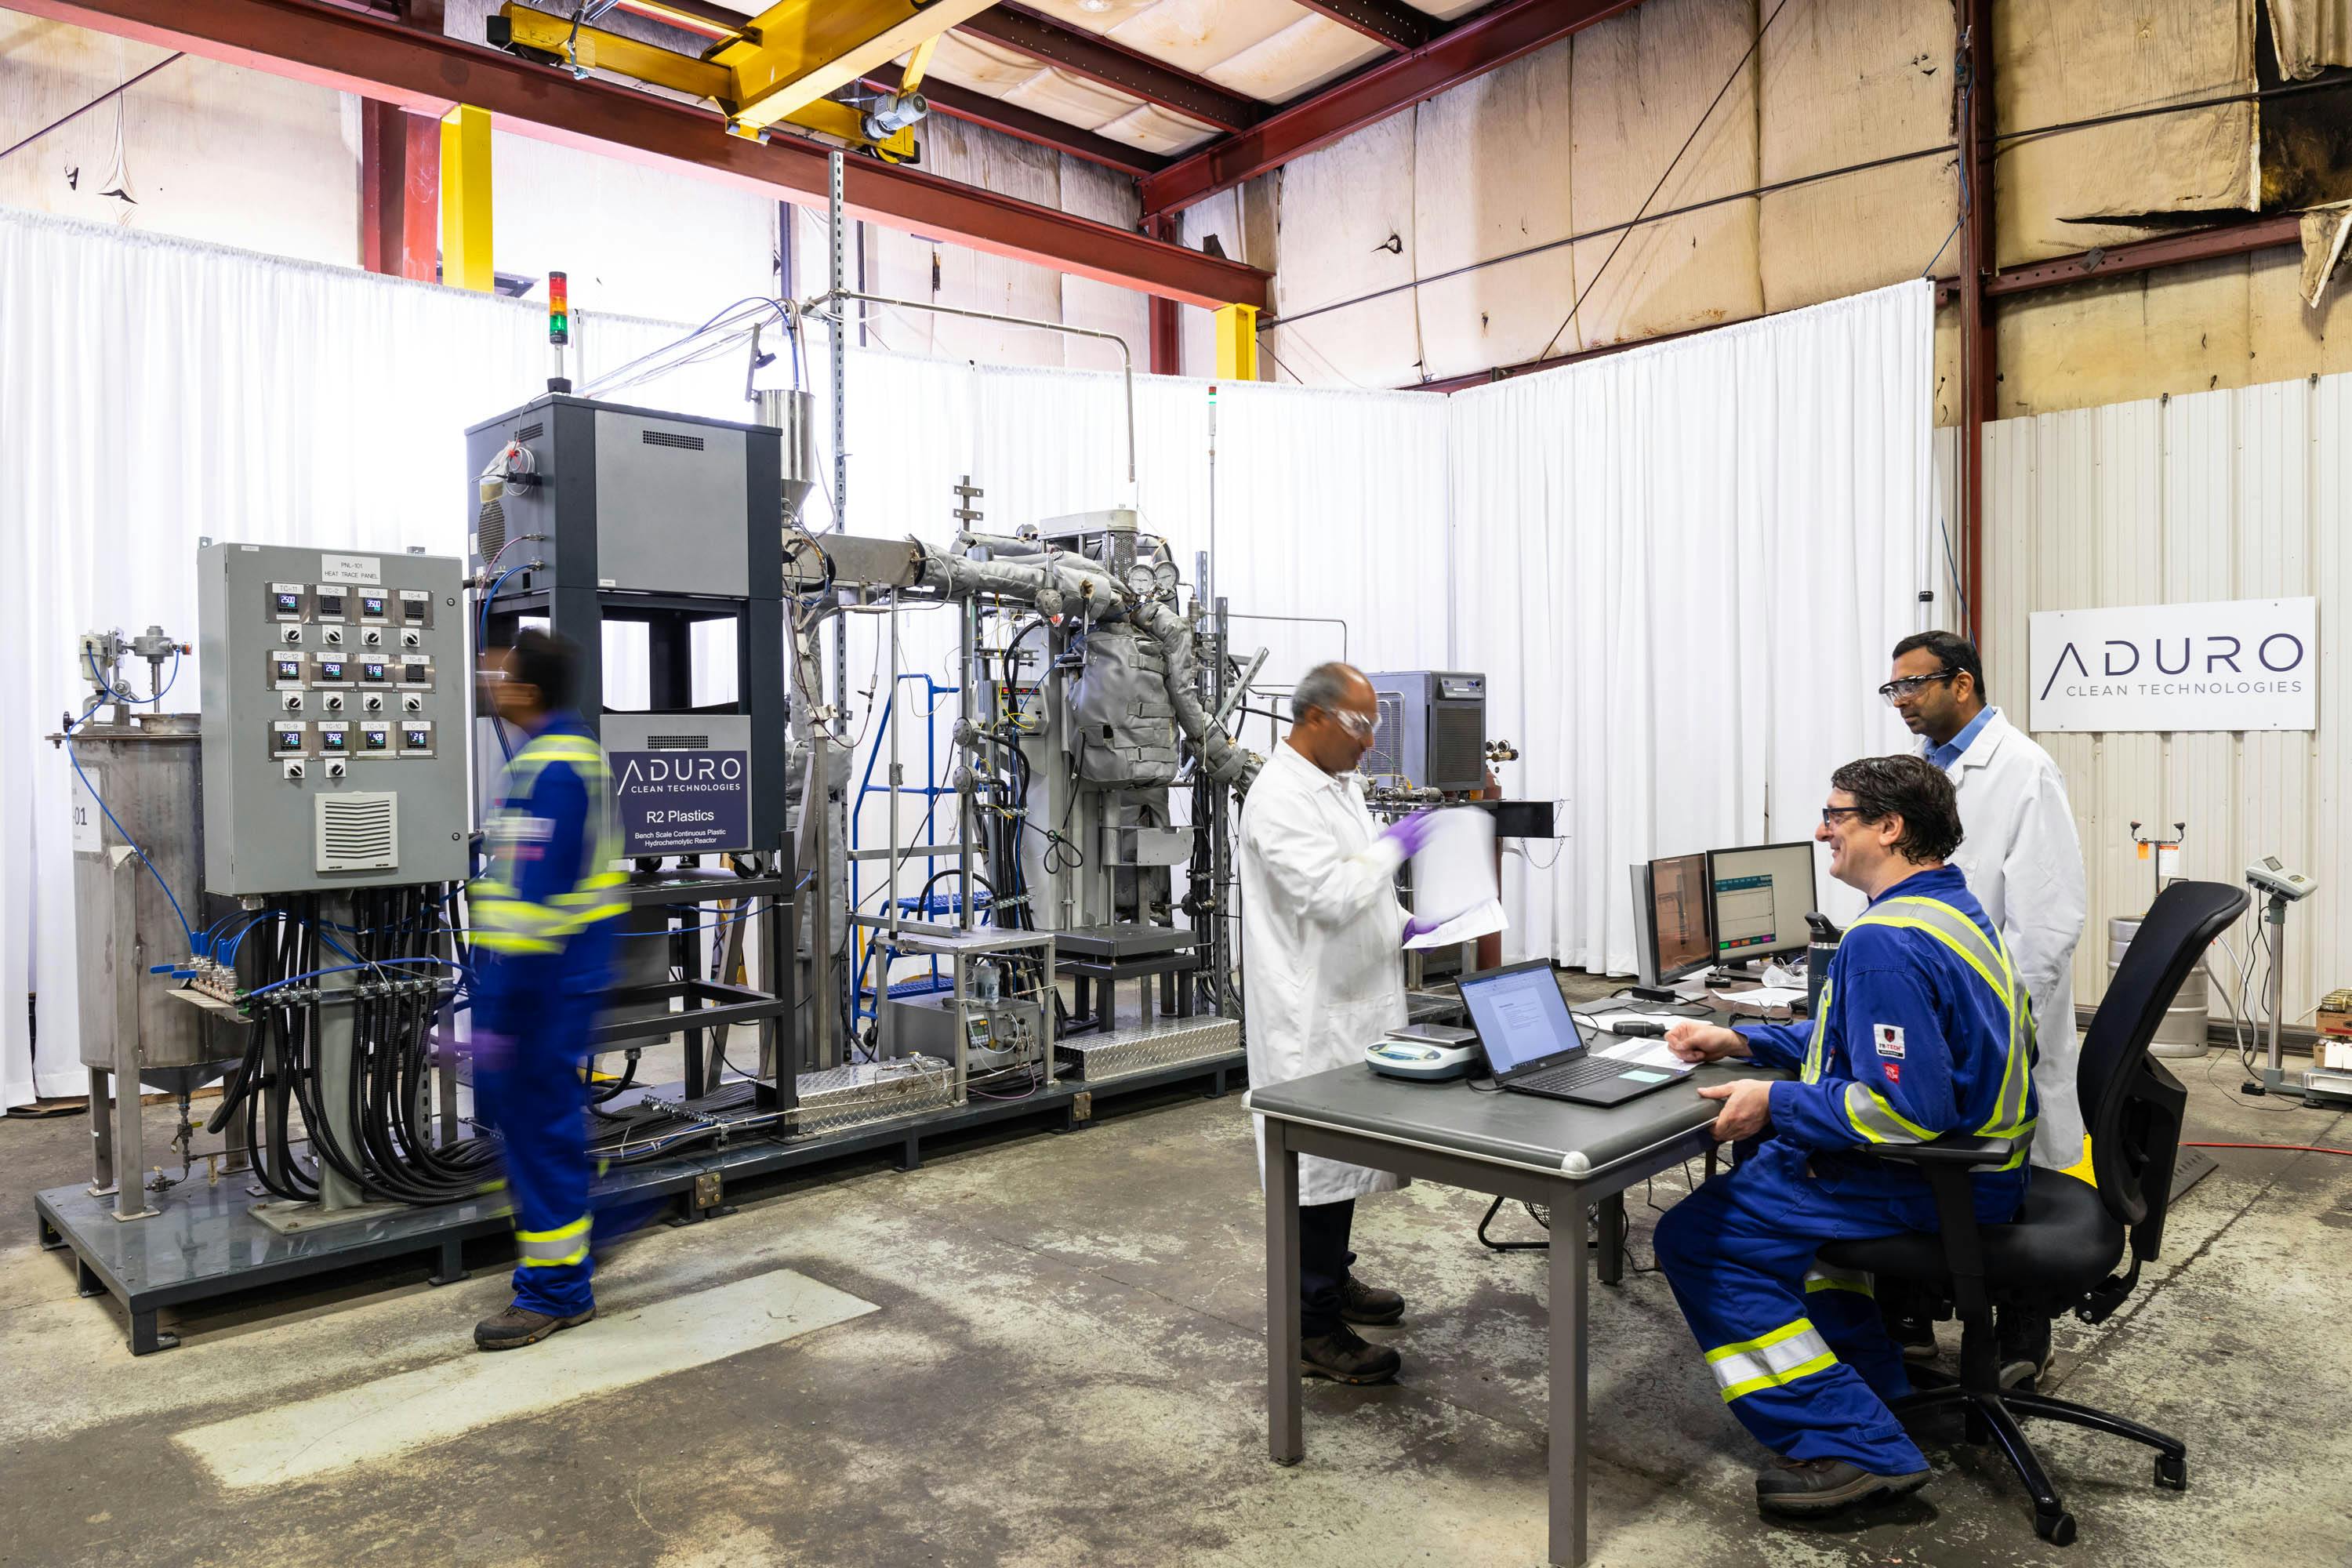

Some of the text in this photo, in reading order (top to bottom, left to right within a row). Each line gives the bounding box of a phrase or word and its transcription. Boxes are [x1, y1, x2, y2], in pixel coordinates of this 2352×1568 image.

[2040, 633, 2303, 701] ADURO
[2066, 681, 2303, 697] CLEAN TECHNOLOGIES
[617, 758, 741, 796] ADURO
[668, 783, 741, 793] TECHNOLOGIES
[647, 810, 714, 823] R2 Plastics
[644, 839, 693, 848] Hydrochemolytic
